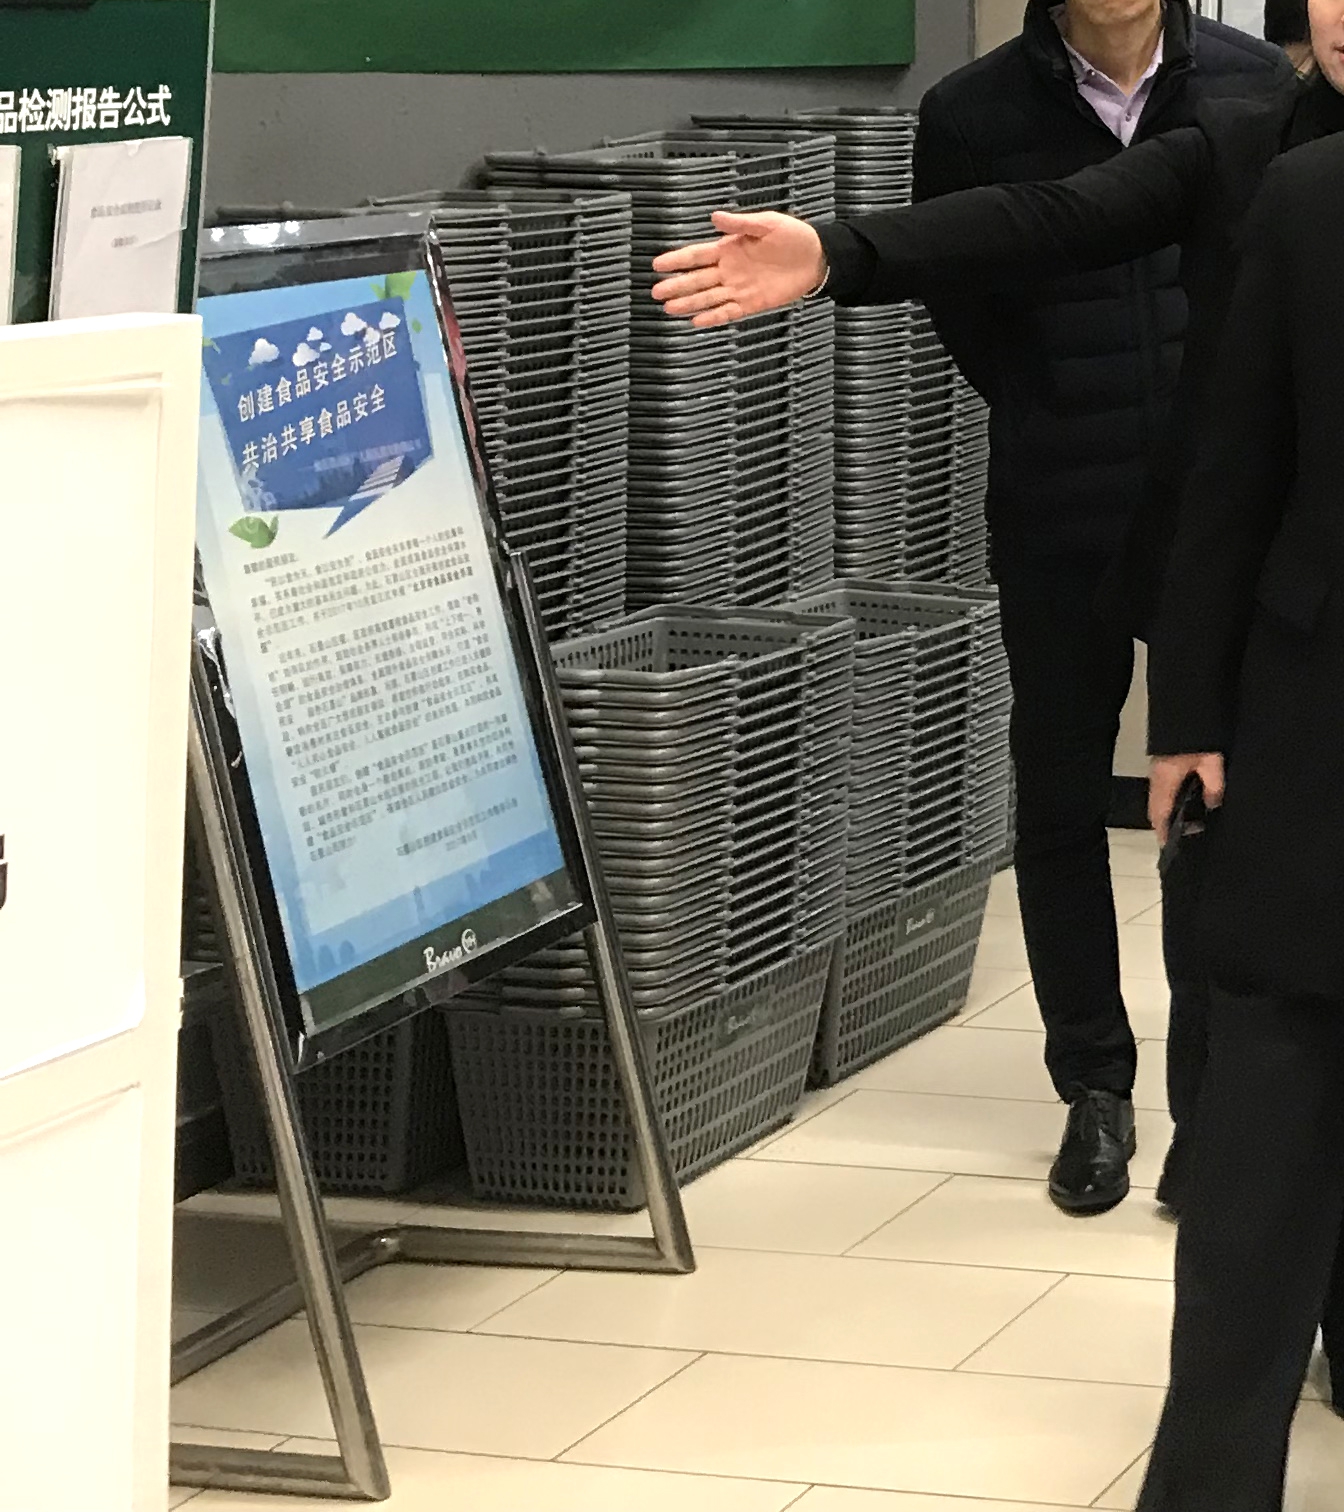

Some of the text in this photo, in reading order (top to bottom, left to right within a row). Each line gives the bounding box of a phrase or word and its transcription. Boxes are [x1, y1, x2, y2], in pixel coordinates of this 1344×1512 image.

[237, 330, 398, 423] 创建食品安全示范区
[241, 384, 386, 472] 共治共享食品安全
